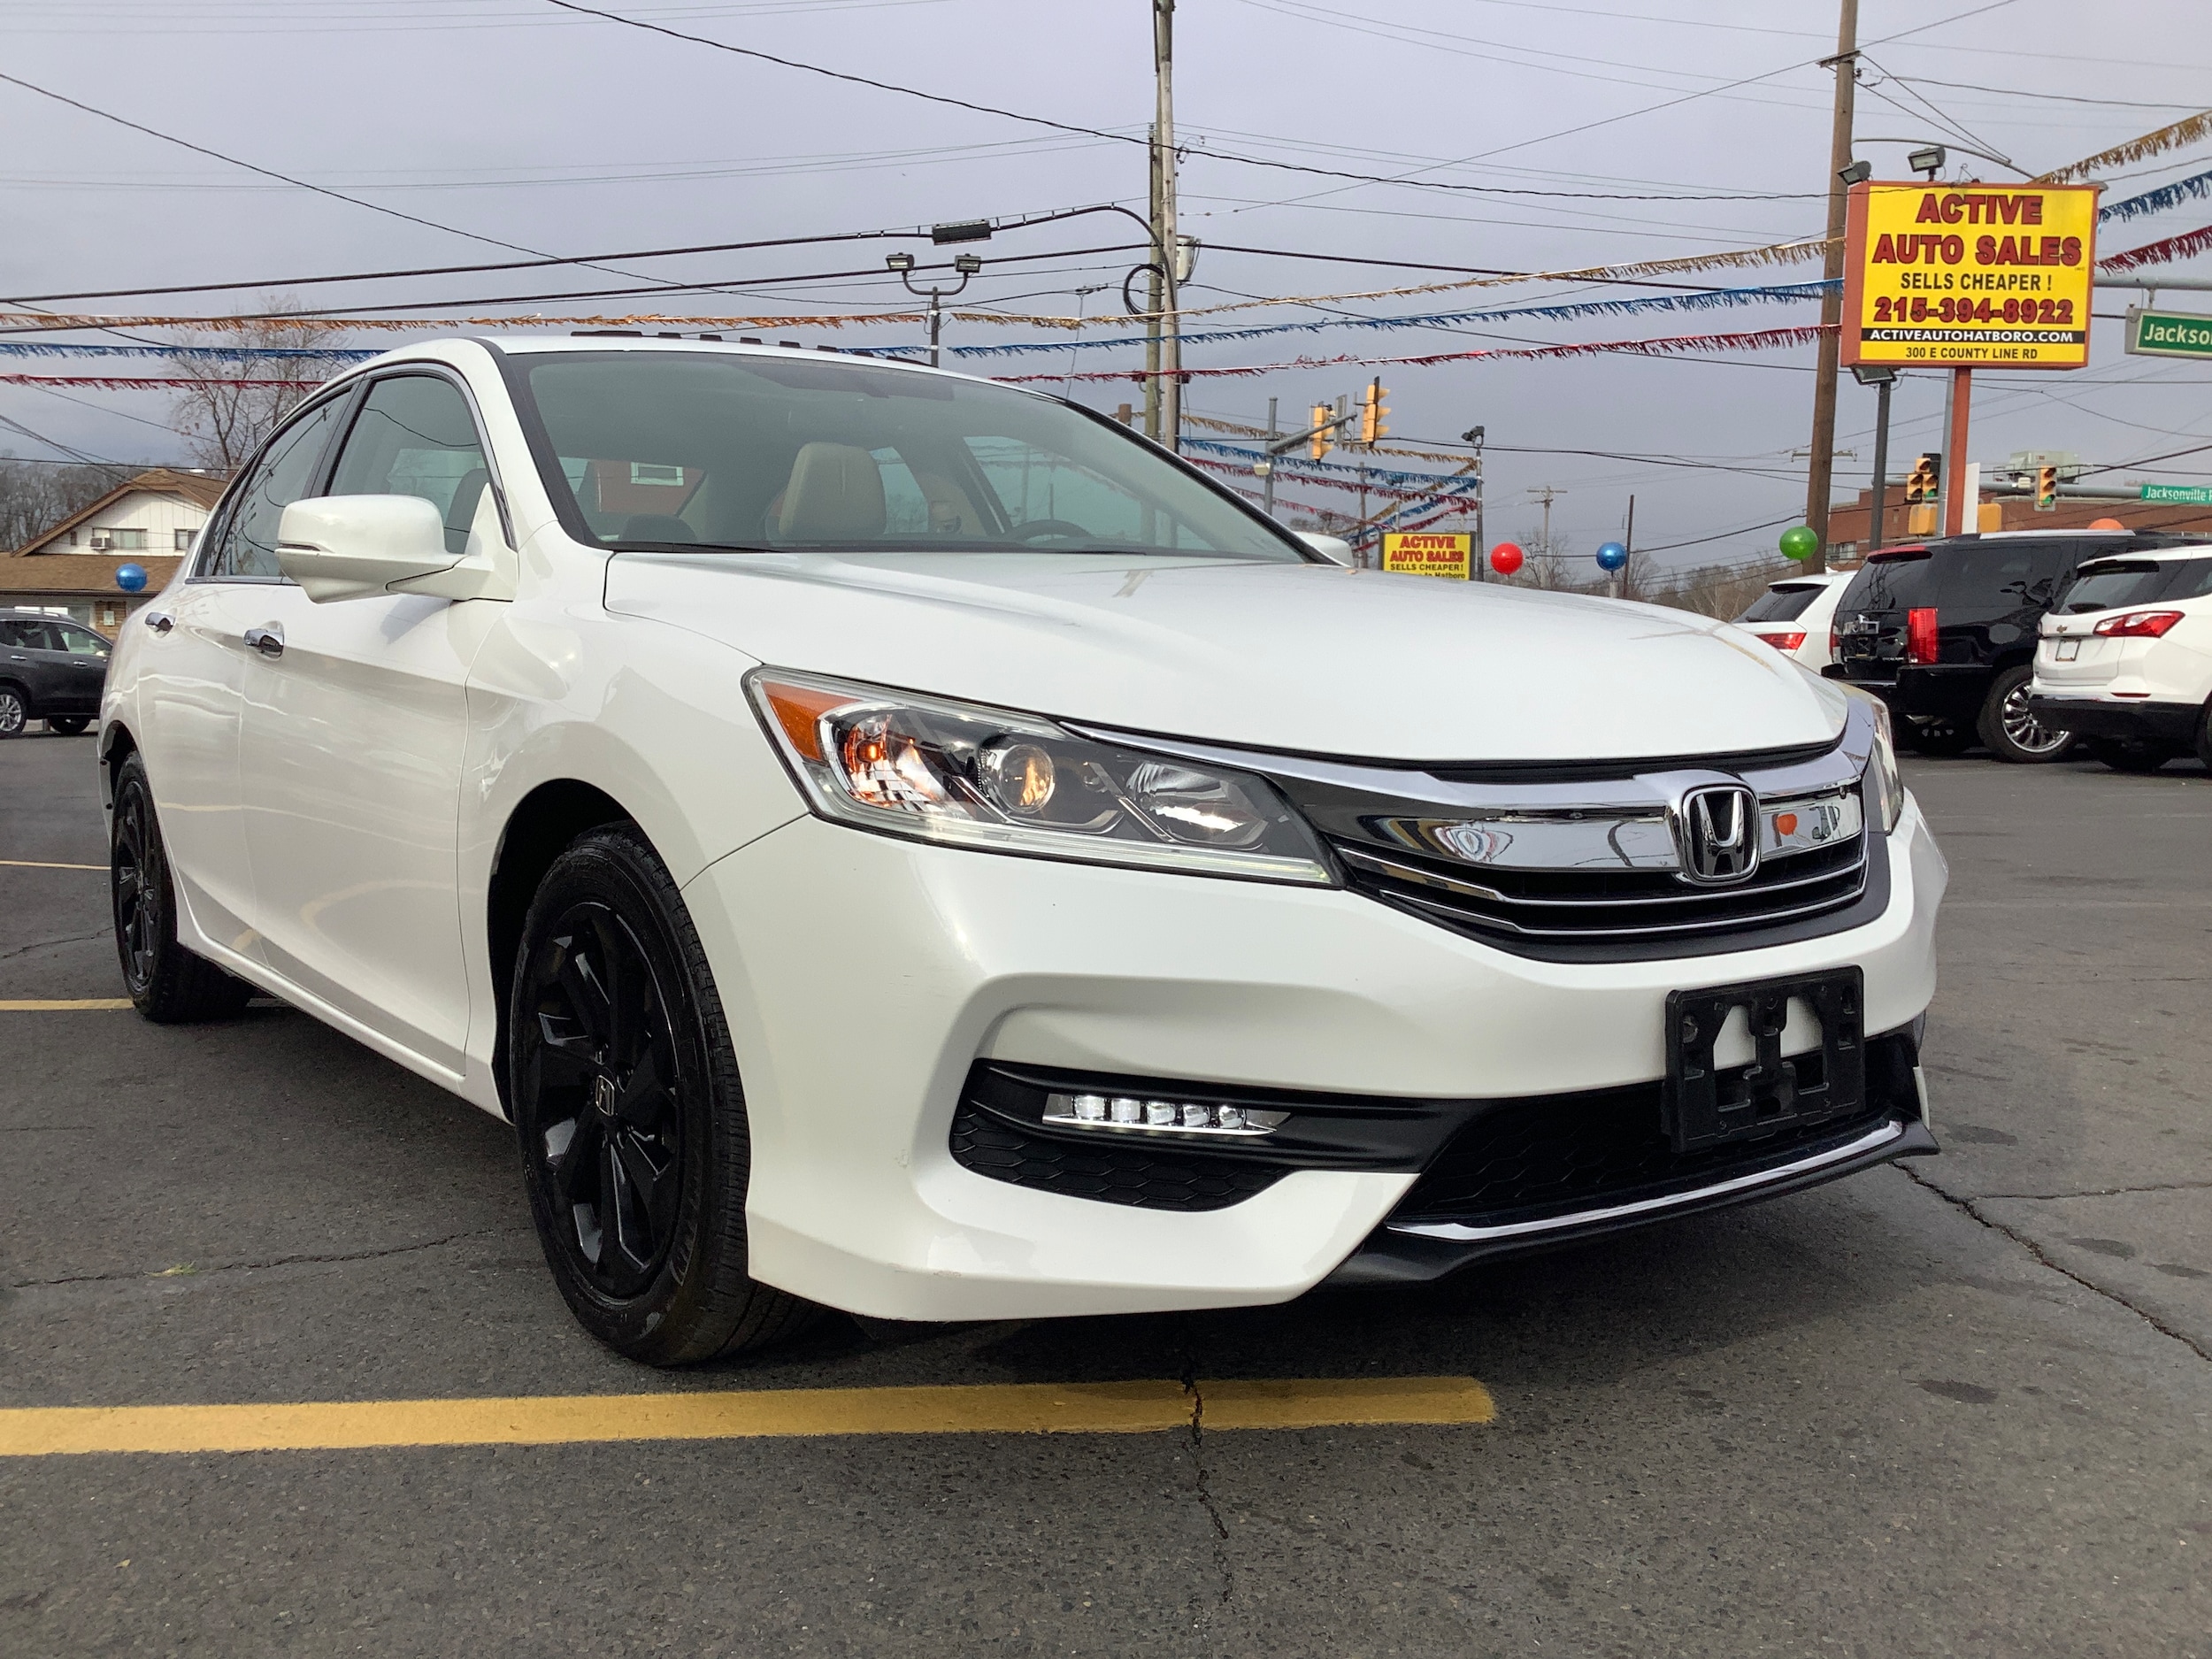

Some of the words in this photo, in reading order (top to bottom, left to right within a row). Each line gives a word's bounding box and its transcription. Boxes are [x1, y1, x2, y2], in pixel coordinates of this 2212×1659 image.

[1916, 194, 2043, 225] ACTIVE
[1871, 234, 1964, 265] AUTO
[1975, 235, 2082, 266] SALES
[1901, 273, 1954, 289] SELLS
[1960, 273, 2041, 291] CHEAPER
[1873, 296, 2073, 324] 215-394-8922
[1870, 330, 2073, 342] ACTIVEAUTOHATBORO.COM
[2144, 323, 2212, 345] Jackso
[1906, 347, 1926, 358] 300
[1930, 348, 1937, 358] E
[1940, 348, 1988, 359] COUNTY
[1992, 349, 2019, 358] LINE
[2023, 349, 2038, 359] RD
[2146, 486, 2206, 502] Jacksonville
[1400, 535, 1455, 549] ACTIVE
[1389, 550, 1424, 563] AUTO
[1425, 550, 1464, 563] SALES
